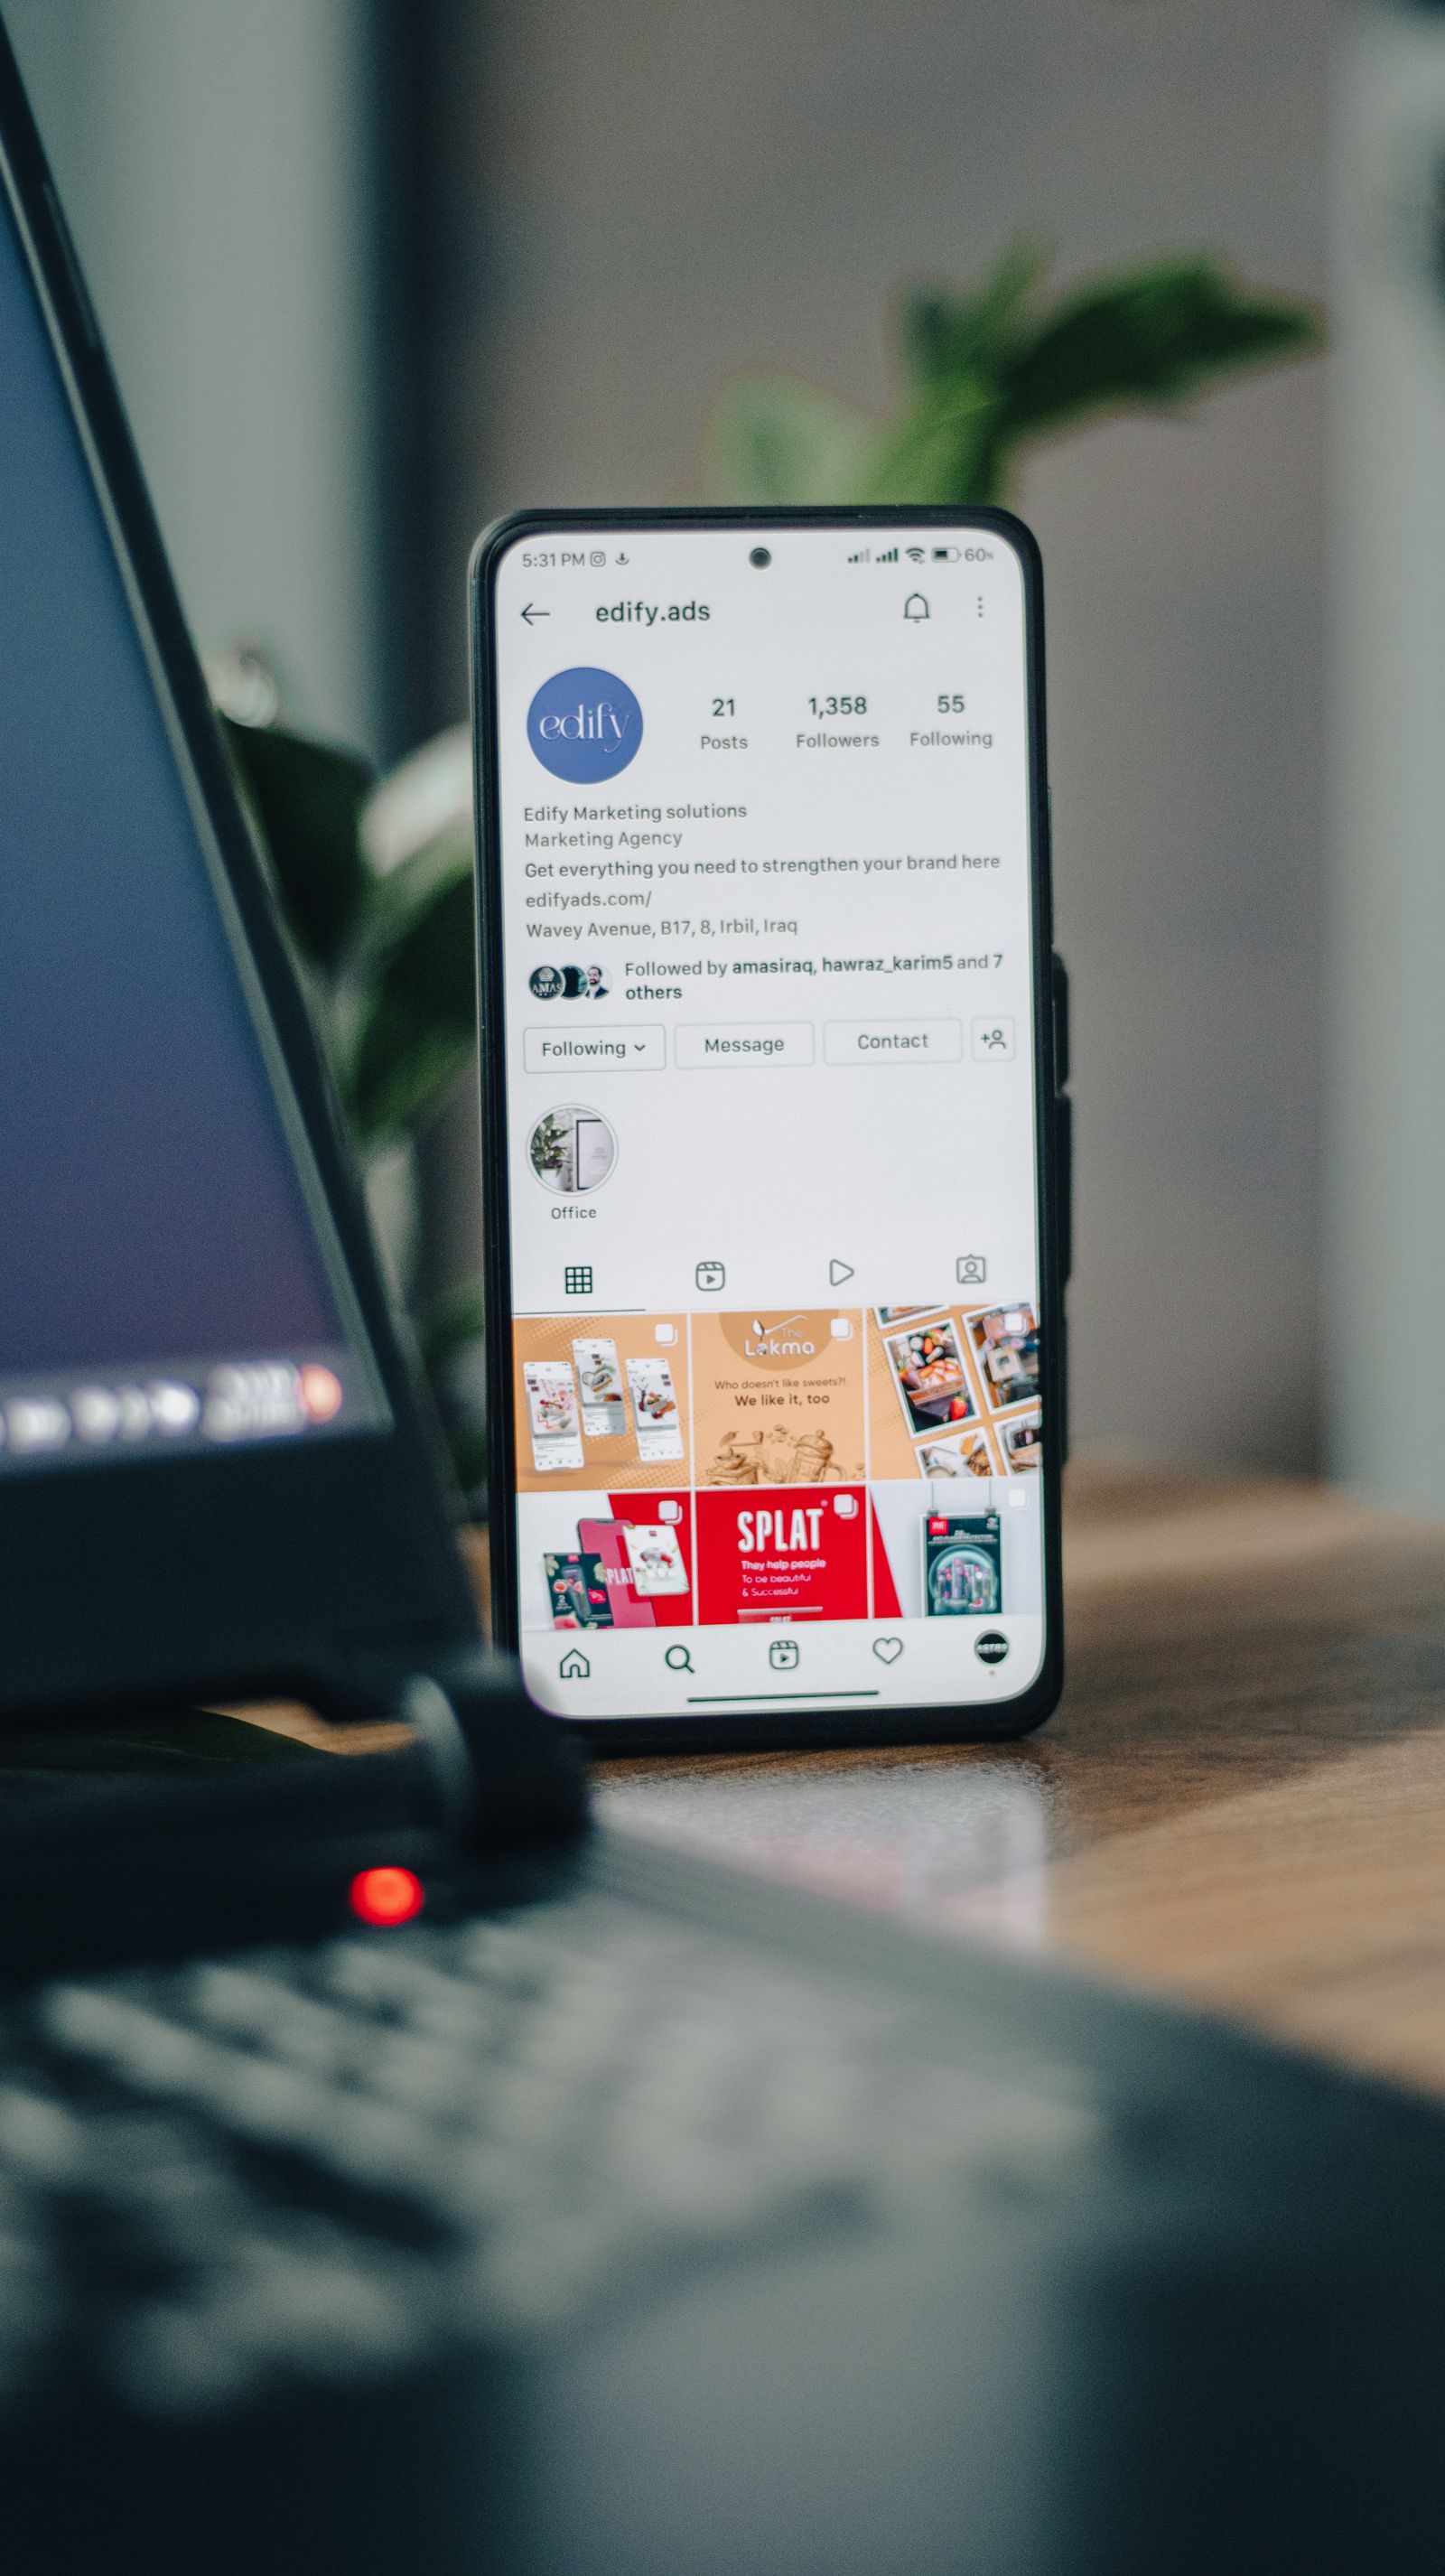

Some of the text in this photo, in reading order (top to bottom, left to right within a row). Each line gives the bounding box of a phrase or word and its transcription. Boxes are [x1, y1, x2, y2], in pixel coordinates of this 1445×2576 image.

[522, 552, 585, 568] 5:31 PM
[595, 600, 711, 627] edify.ads
[712, 697, 735, 717] 21
[807, 695, 868, 720] 1,358
[937, 694, 965, 714] 55
[539, 703, 629, 753] edify
[700, 734, 749, 751] Posts
[796, 733, 881, 749] Followers
[909, 730, 993, 750] Following
[523, 802, 748, 825] Edify Marketing solutions
[525, 831, 683, 851] Marketing Agency
[524, 854, 1001, 881] Get everything you need to strengthen your brand here
[525, 891, 653, 911] edifyads.com/
[525, 917, 798, 941] Wavey Avenue, B17, 8, Irbil, Iraq
[624, 953, 1004, 978] Followed by amasiraq, hawraz_karim5 and 7
[625, 985, 683, 1001] others
[541, 1040, 627, 1059] Following
[704, 1038, 785, 1056] Message
[857, 1033, 929, 1050] Contact
[550, 1206, 597, 1220] Office
[714, 1377, 846, 1390] Who doesn't like sweets?!
[734, 1393, 830, 1406] We like it, too
[737, 1508, 824, 1553] SPLAT
[741, 1558, 826, 1572] They help people
[741, 1574, 753, 1584] To
